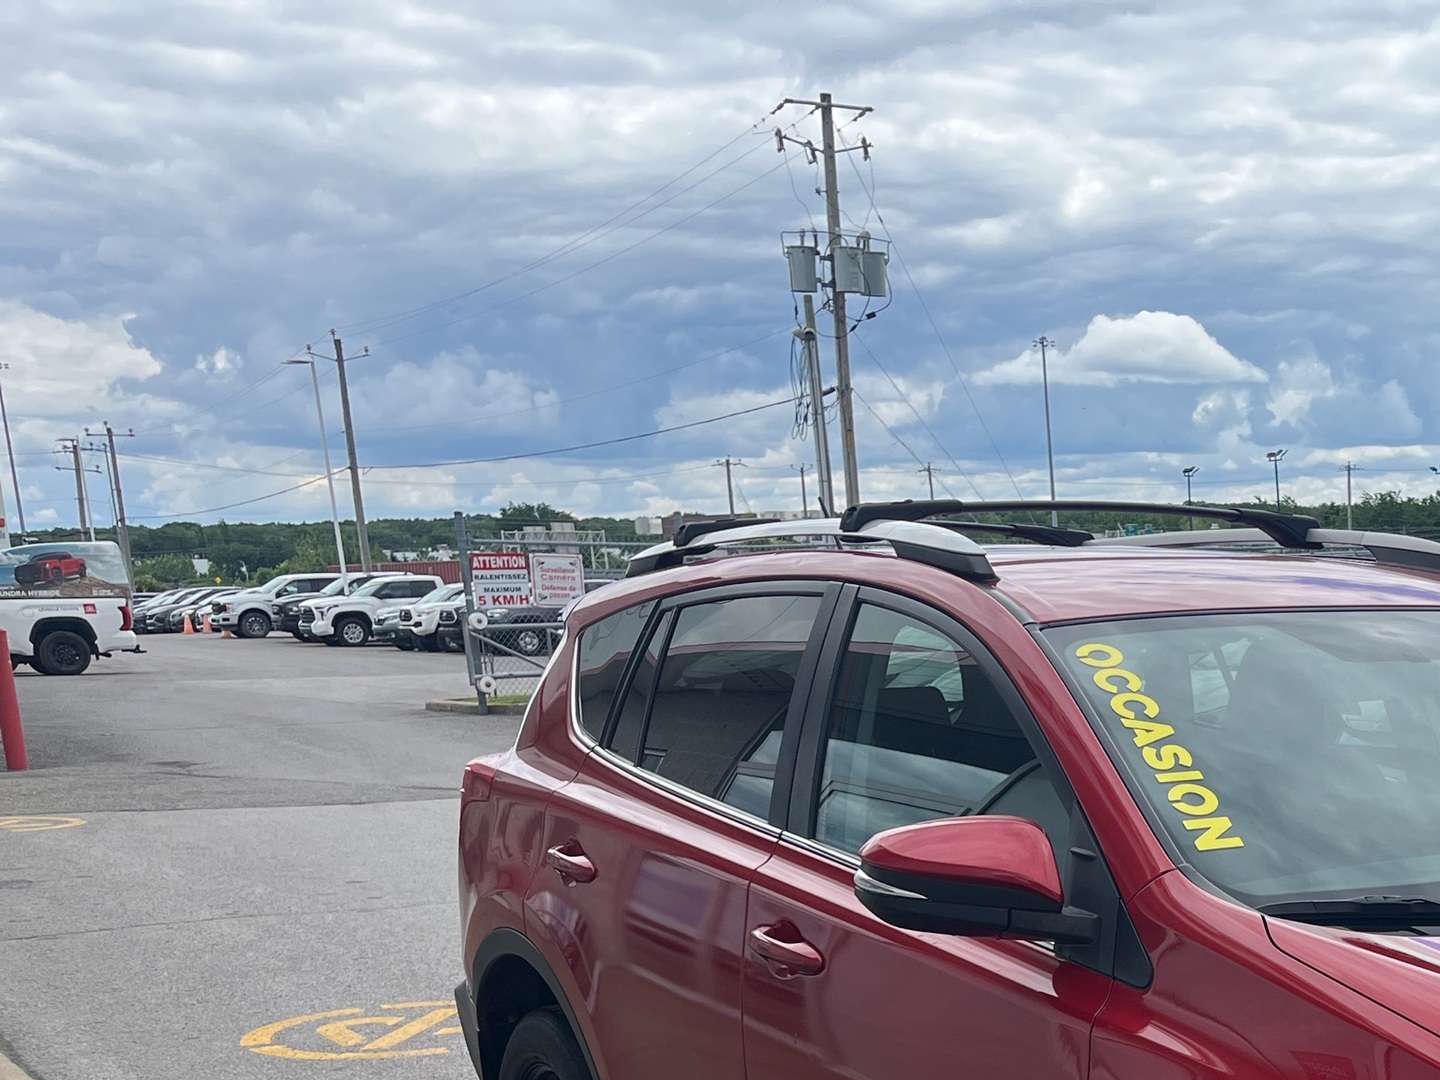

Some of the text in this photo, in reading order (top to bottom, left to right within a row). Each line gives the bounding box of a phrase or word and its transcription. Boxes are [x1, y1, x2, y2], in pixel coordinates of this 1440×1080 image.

[473, 556, 525, 568] ATTENTION
[478, 595, 529, 606] 5 KM/H
[1075, 642, 1245, 852] OCCASION
